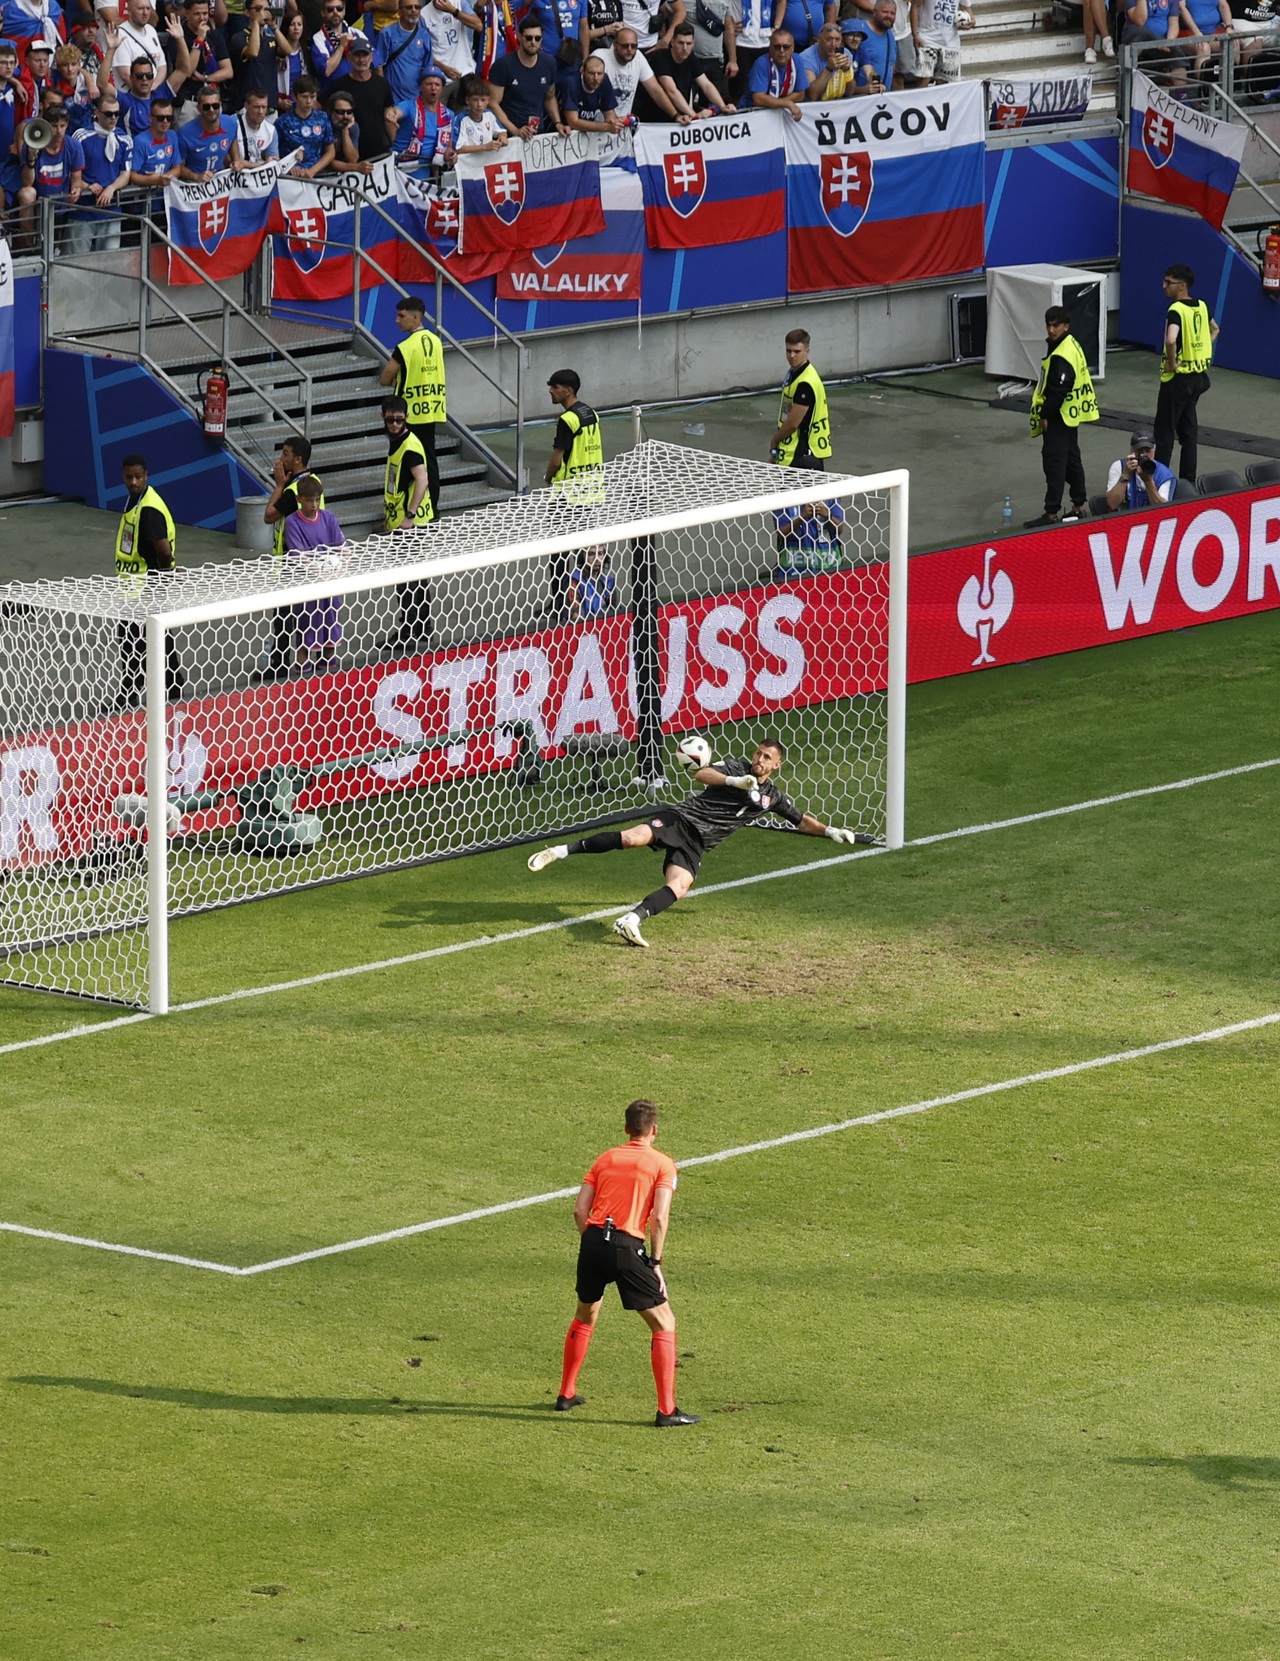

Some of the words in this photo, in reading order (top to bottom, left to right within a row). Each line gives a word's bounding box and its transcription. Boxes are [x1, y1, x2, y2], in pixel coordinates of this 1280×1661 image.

[444, 28, 459, 46] 12
[993, 82, 1016, 106] 38
[669, 122, 752, 148] DUBOVICA
[815, 103, 951, 146] ĎAČOV
[522, 130, 591, 171] POPRAD
[316, 163, 391, 213] CABAJ
[510, 272, 630, 293] VALALIKY
[115, 558, 140, 573] ARD
[370, 592, 807, 781] STRAUSS
